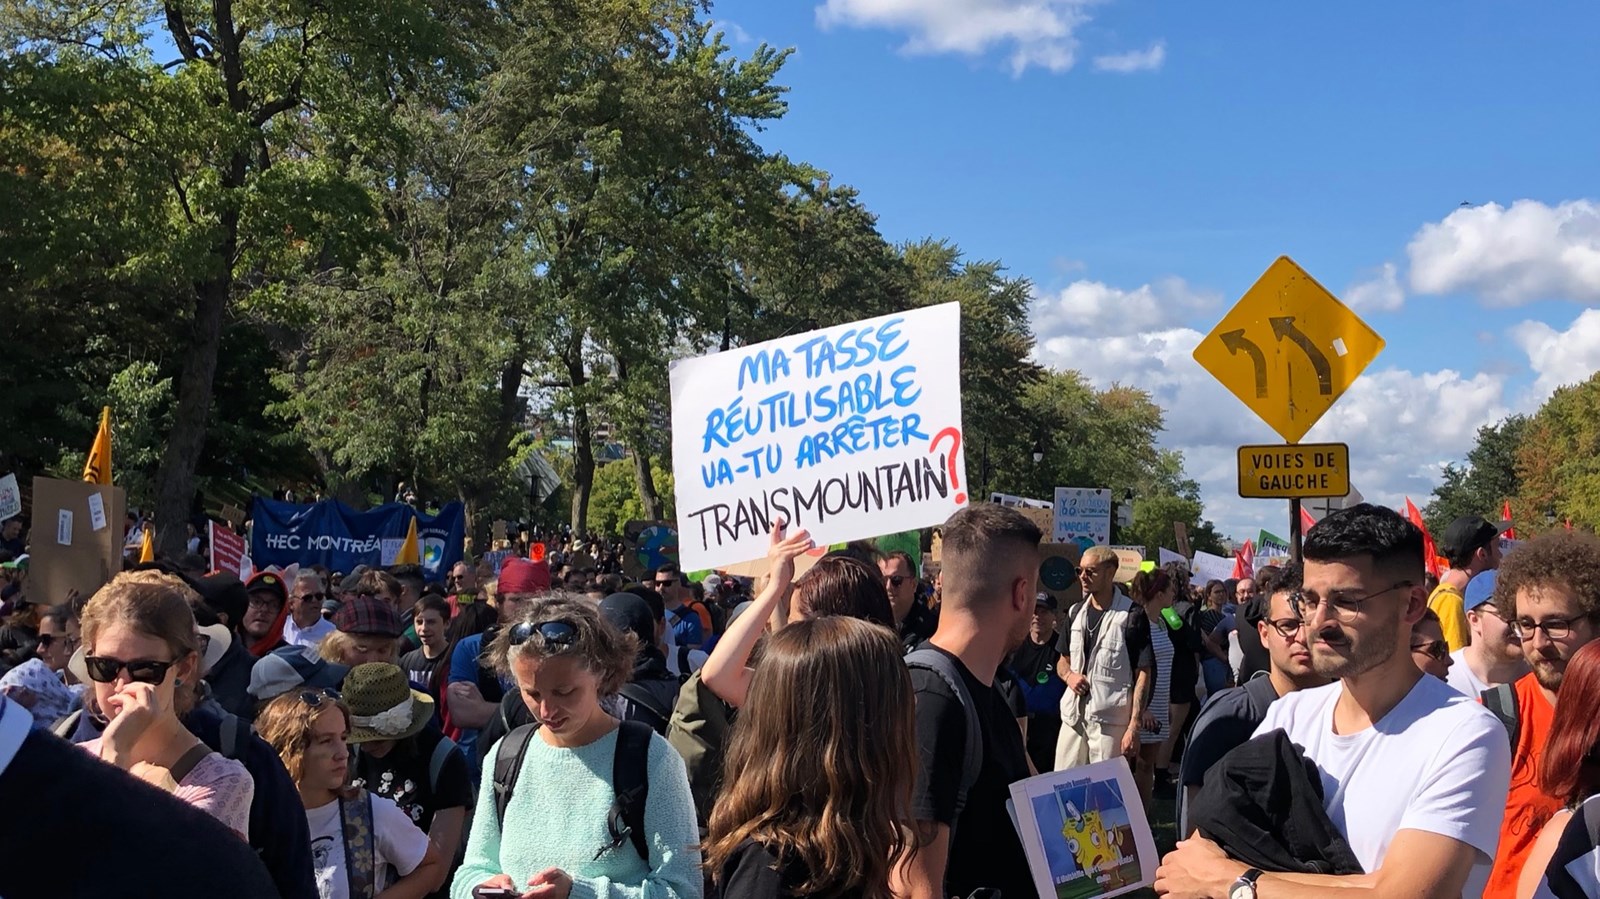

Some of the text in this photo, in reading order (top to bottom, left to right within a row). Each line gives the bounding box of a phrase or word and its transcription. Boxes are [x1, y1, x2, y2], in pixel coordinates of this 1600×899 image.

[738, 318, 910, 392] MA TASSE
[701, 365, 922, 454] RÉUTILISABLE
[795, 413, 930, 470] ARRÊTER
[1252, 452, 1336, 469] VOIES DE
[1260, 473, 1329, 490] GAUCHE
[265, 533, 300, 550] HEC
[307, 534, 382, 553] MONTRÉA
